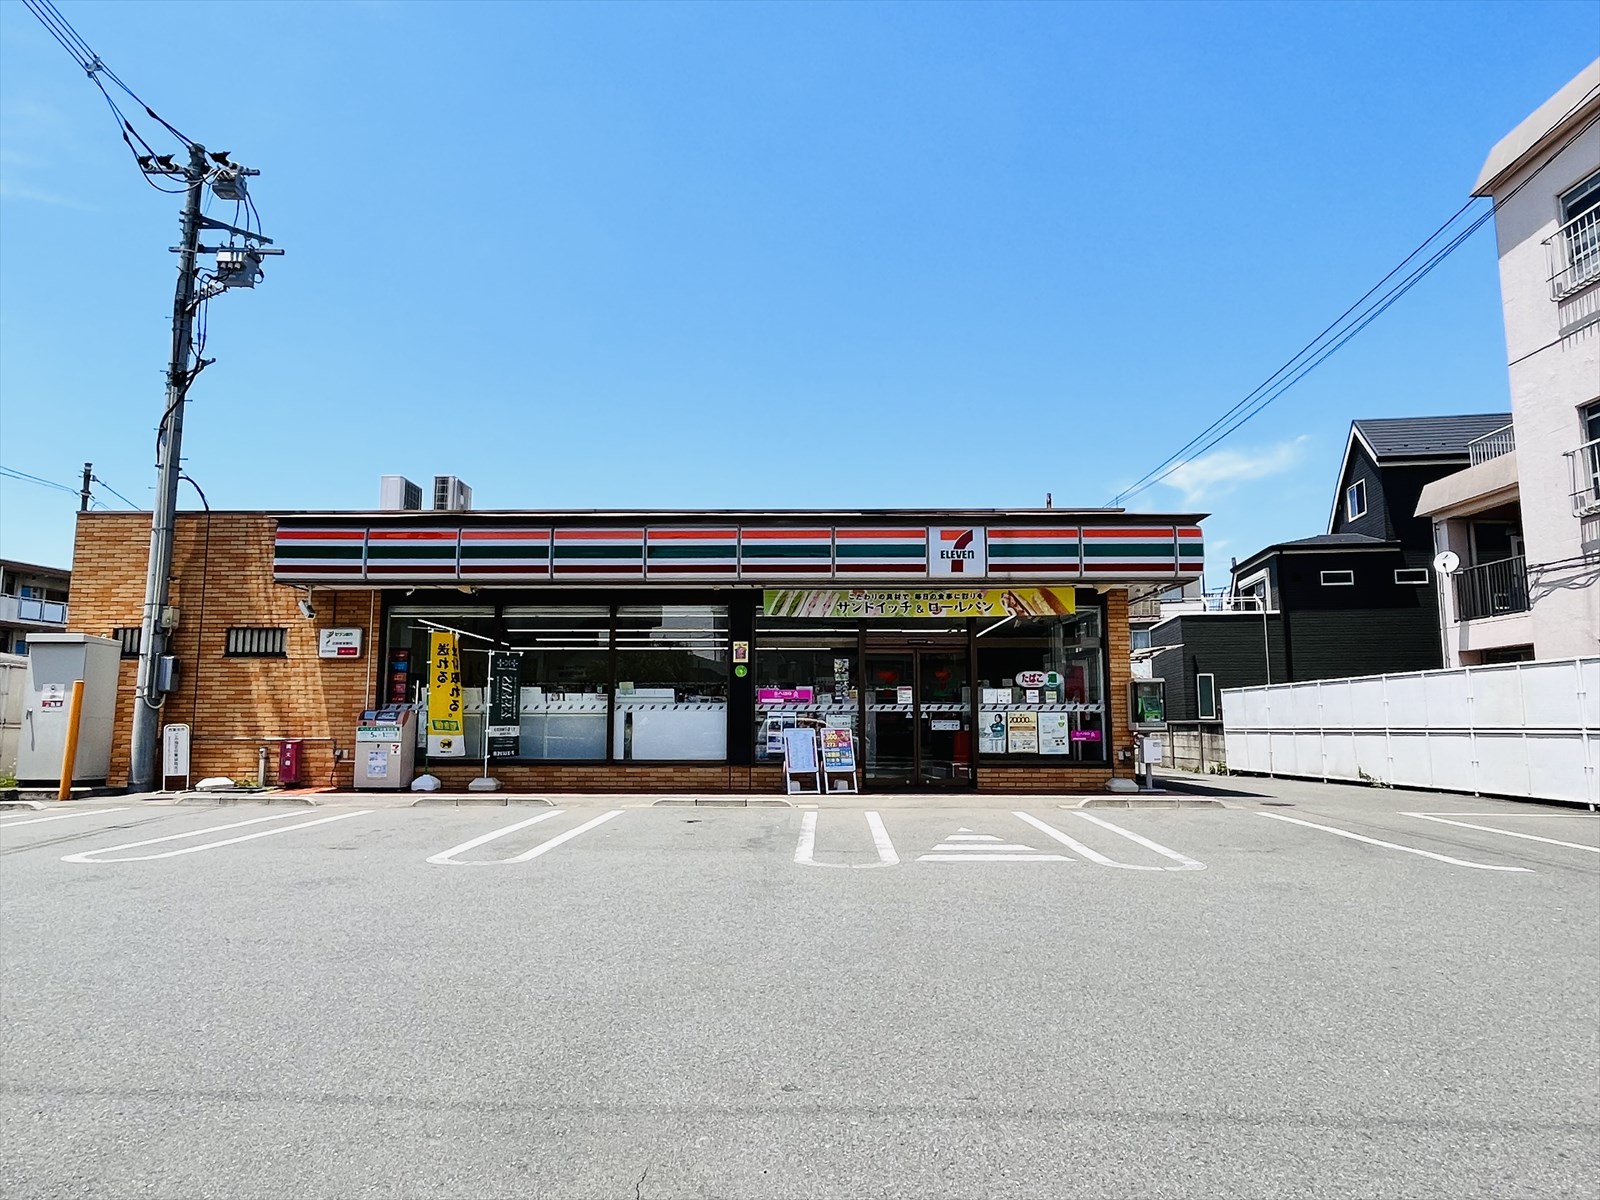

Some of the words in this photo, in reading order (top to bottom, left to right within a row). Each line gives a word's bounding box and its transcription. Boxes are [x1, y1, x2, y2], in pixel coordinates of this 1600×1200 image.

[837, 601, 912, 613] サンドイッチ
[916, 604, 924, 613] &
[929, 601, 994, 613] ロールパン
[1022, 673, 1043, 683] たばこ
